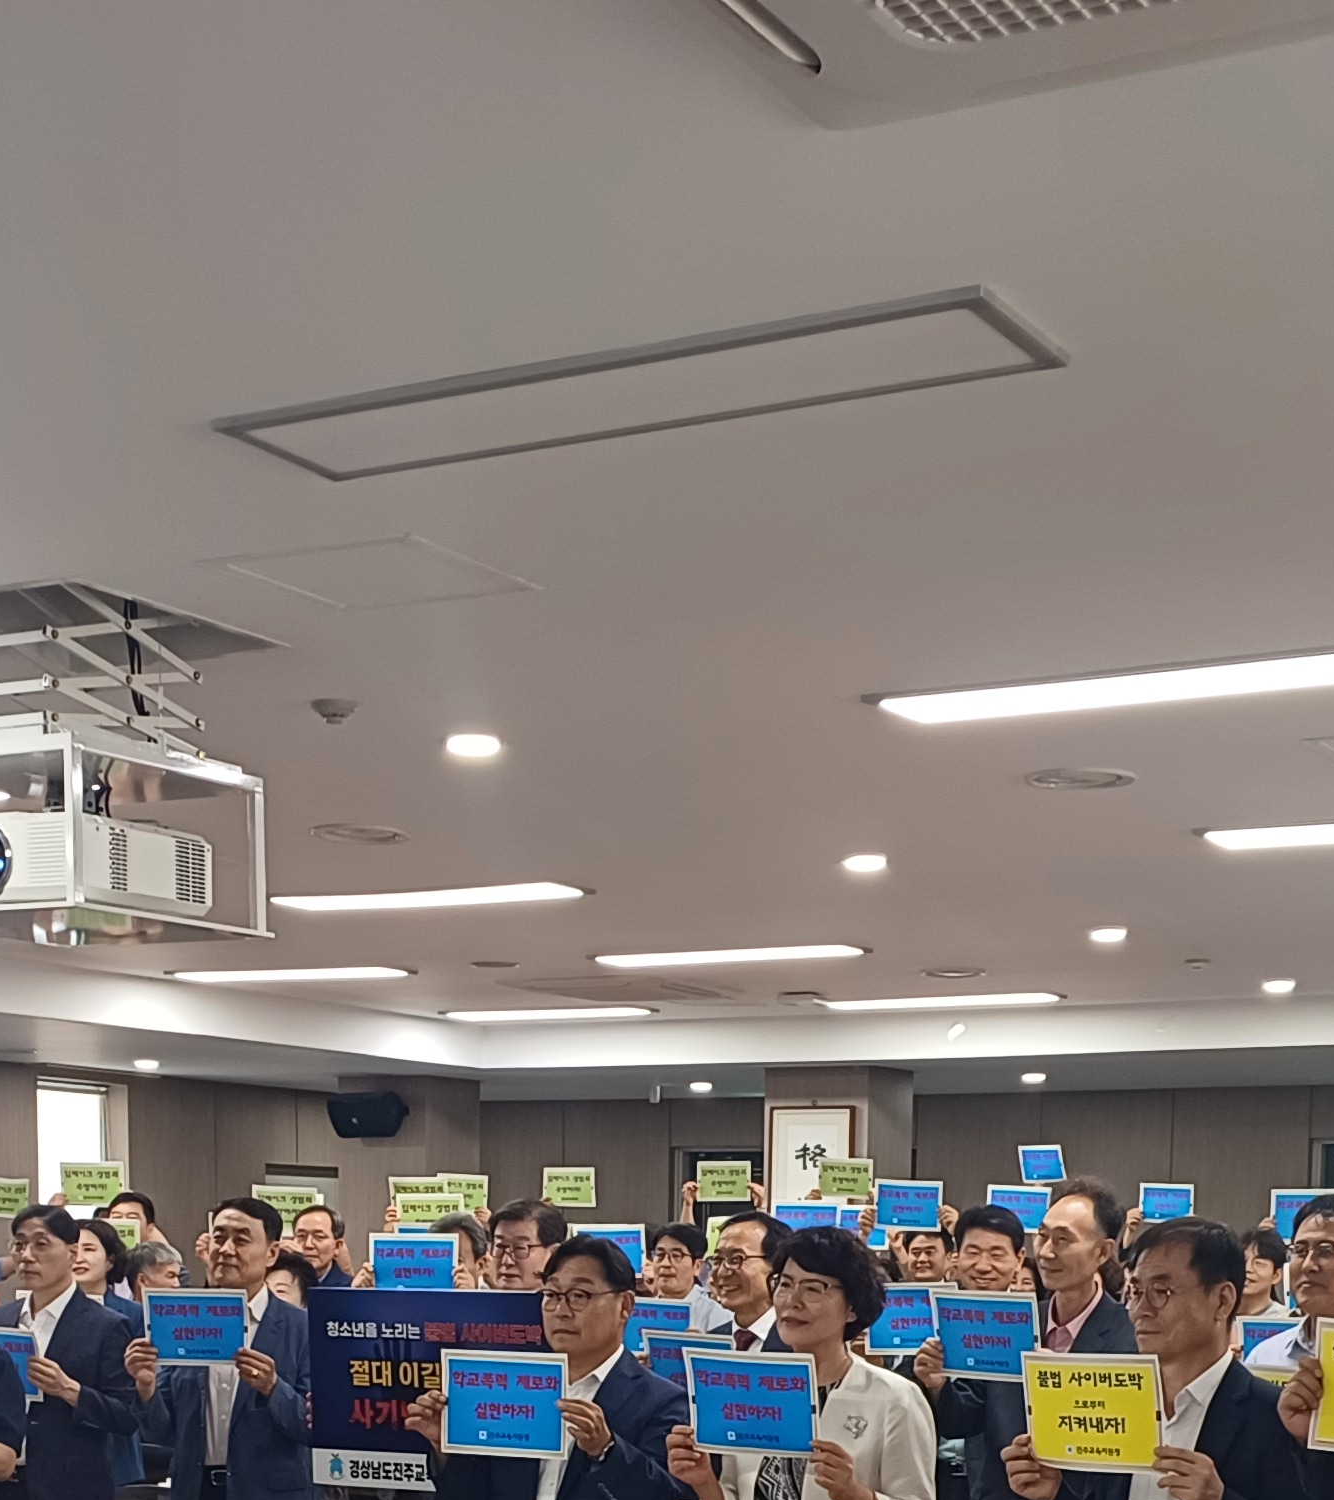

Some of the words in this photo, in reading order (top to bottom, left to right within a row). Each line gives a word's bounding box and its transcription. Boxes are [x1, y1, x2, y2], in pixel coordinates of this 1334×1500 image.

[153, 1304, 199, 1318] 학교폭력
[206, 1304, 242, 1317] 제로화
[884, 1296, 914, 1308] 교폭력
[631, 1309, 658, 1320] 교폭력
[890, 1317, 933, 1330] 실현하자
[940, 1307, 986, 1325] 학교폭력
[991, 1309, 1030, 1325] 제로화
[173, 1327, 223, 1341] 실현하자!
[326, 1321, 377, 1338] 청소년을
[381, 1323, 421, 1339] 노리는
[461, 1324, 542, 1345] 사이버도박
[960, 1334, 1011, 1349] 실현하자!
[349, 1360, 392, 1386] 절대
[399, 1362, 441, 1390] 이길
[453, 1371, 508, 1390] 학교폭력
[516, 1375, 559, 1391] 제로화
[697, 1370, 750, 1391] 학교폭력
[759, 1374, 807, 1392] 제로화
[1037, 1370, 1062, 1389] 불법
[1069, 1371, 1143, 1391] 사이버도박
[474, 1403, 535, 1420] 실현하자!
[722, 1402, 782, 1421] 실현하자!
[1073, 1399, 1105, 1410] 으로부터
[349, 1399, 409, 1429] 사기
[1058, 1415, 1126, 1434] 지켜내자!
[1075, 1446, 1120, 1457] 진주교육지원청
[349, 1459, 433, 1482] 경상남도진주교
